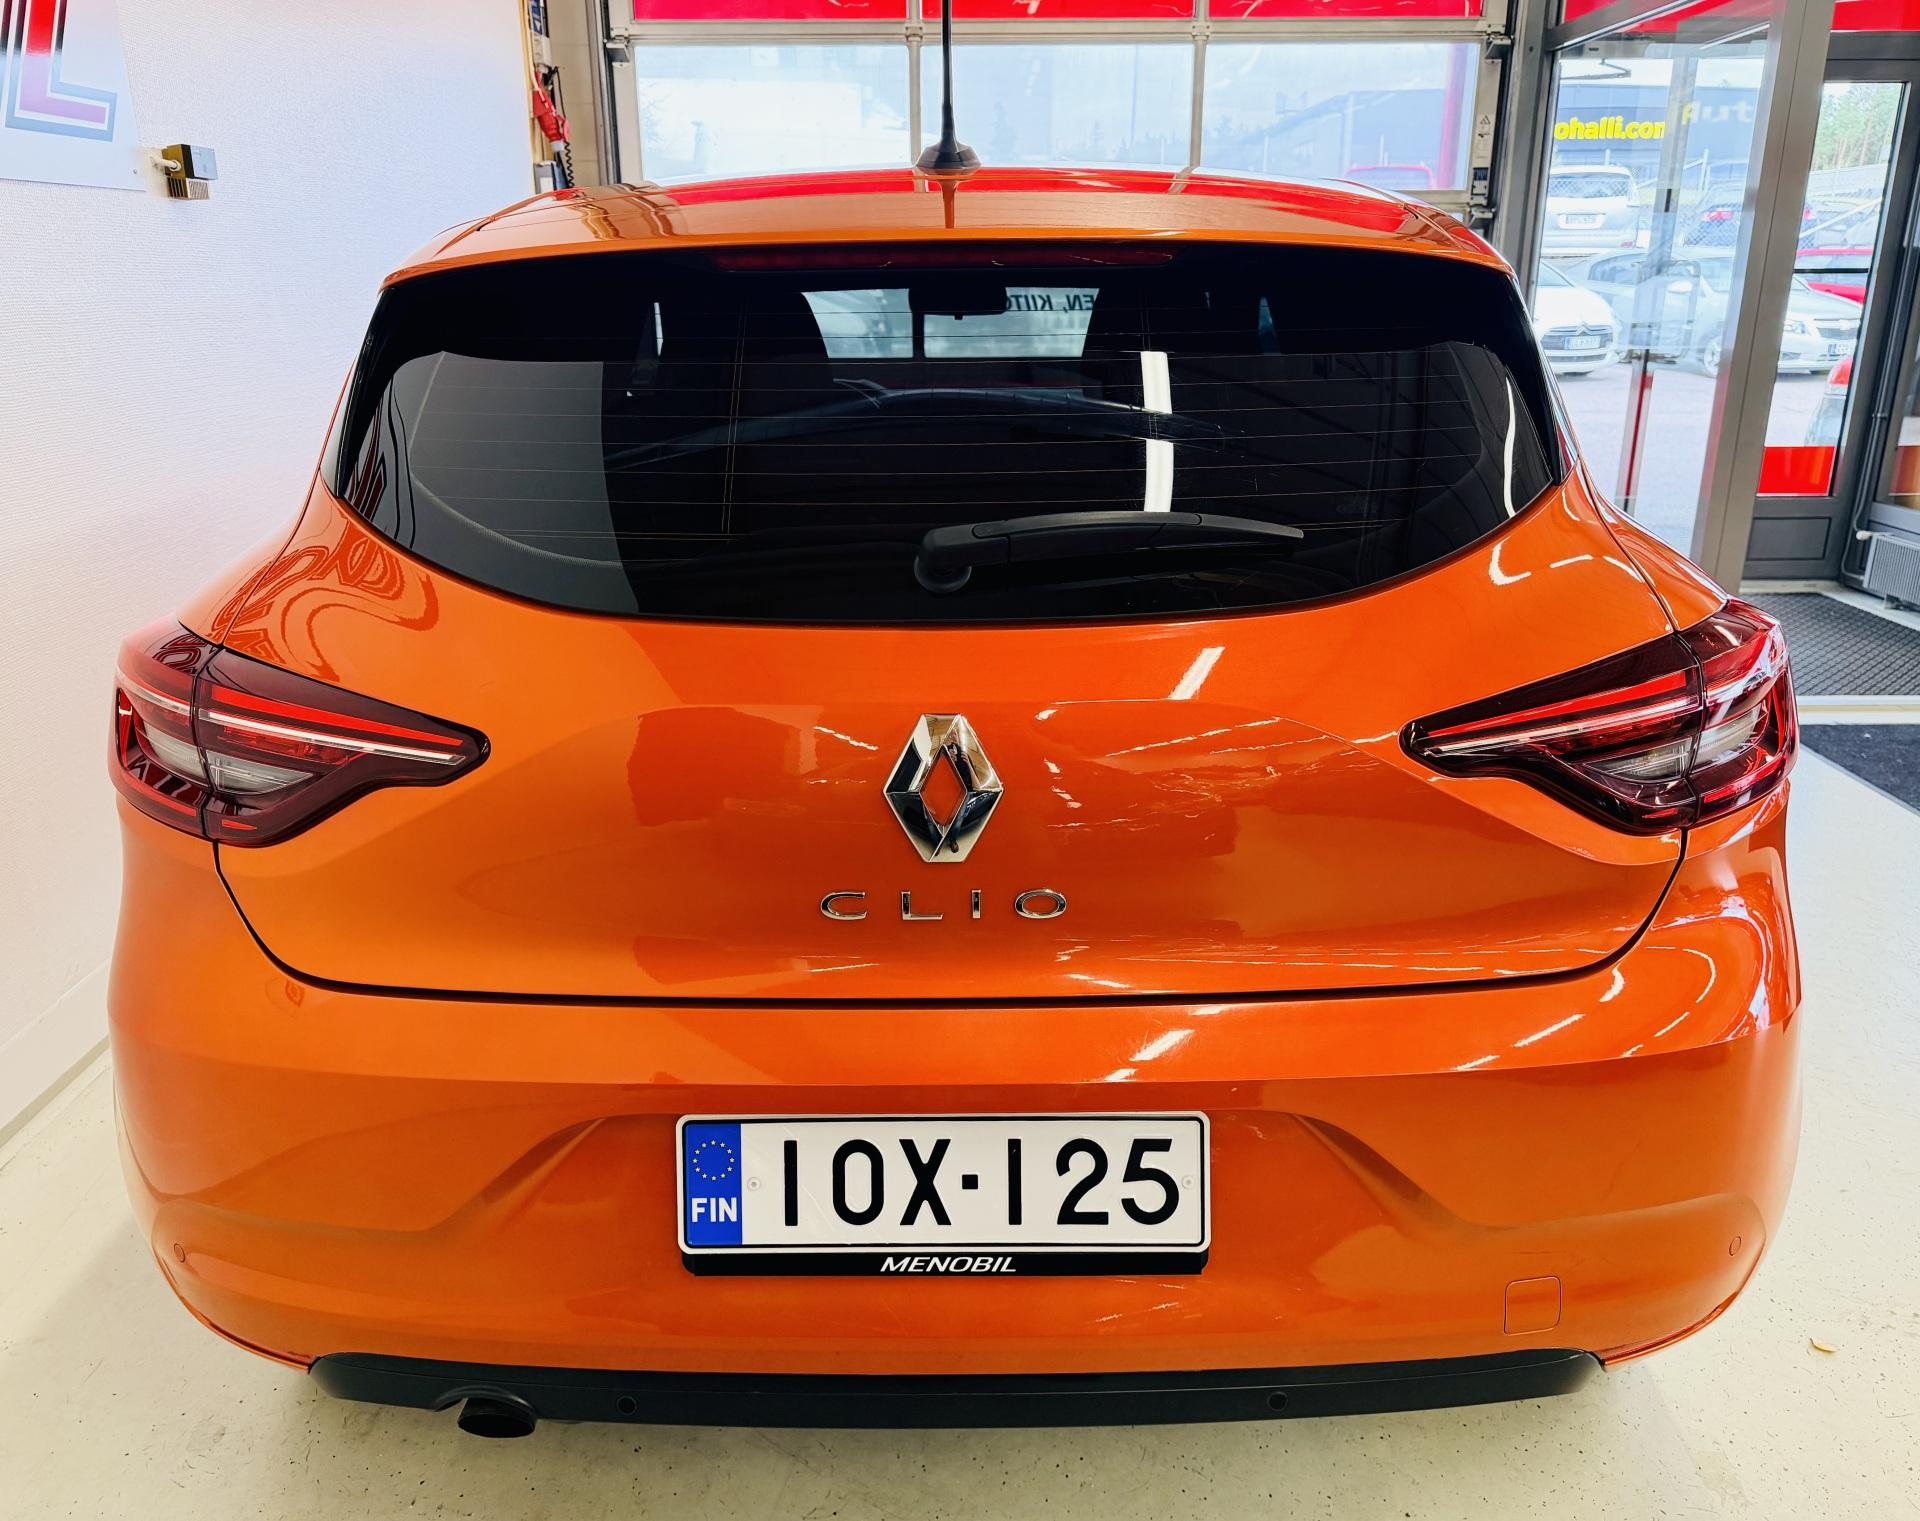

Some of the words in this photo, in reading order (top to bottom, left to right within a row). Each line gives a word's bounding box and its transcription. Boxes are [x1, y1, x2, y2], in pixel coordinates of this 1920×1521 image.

[820, 888, 1068, 921] CLIO
[691, 1197, 738, 1223] FIN
[880, 1256, 1017, 1273] MENOBIL
